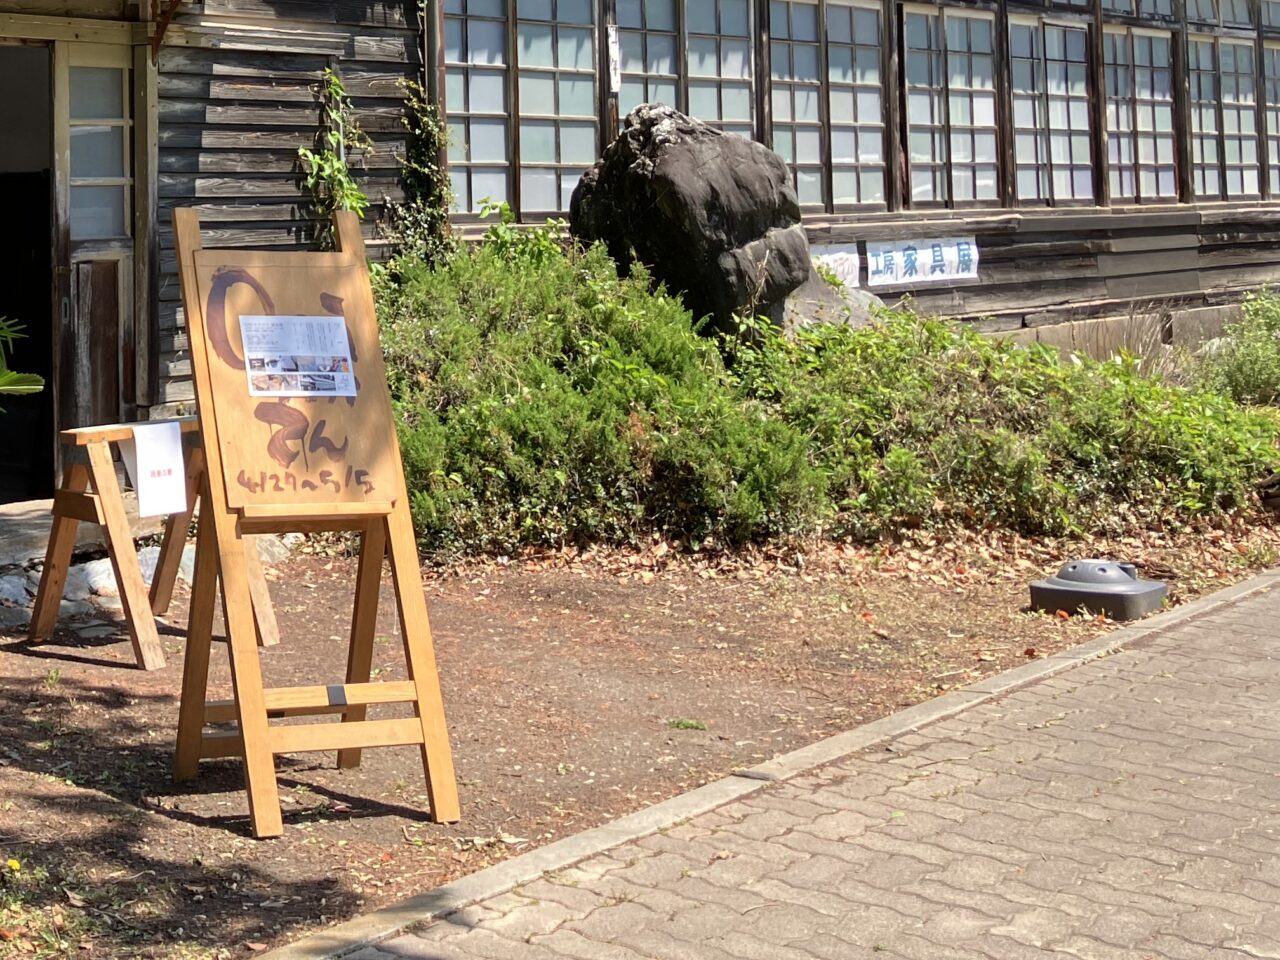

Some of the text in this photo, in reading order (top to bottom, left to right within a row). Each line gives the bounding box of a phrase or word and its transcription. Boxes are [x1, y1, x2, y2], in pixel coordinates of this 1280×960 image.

[871, 242, 972, 277] 工房家具展
